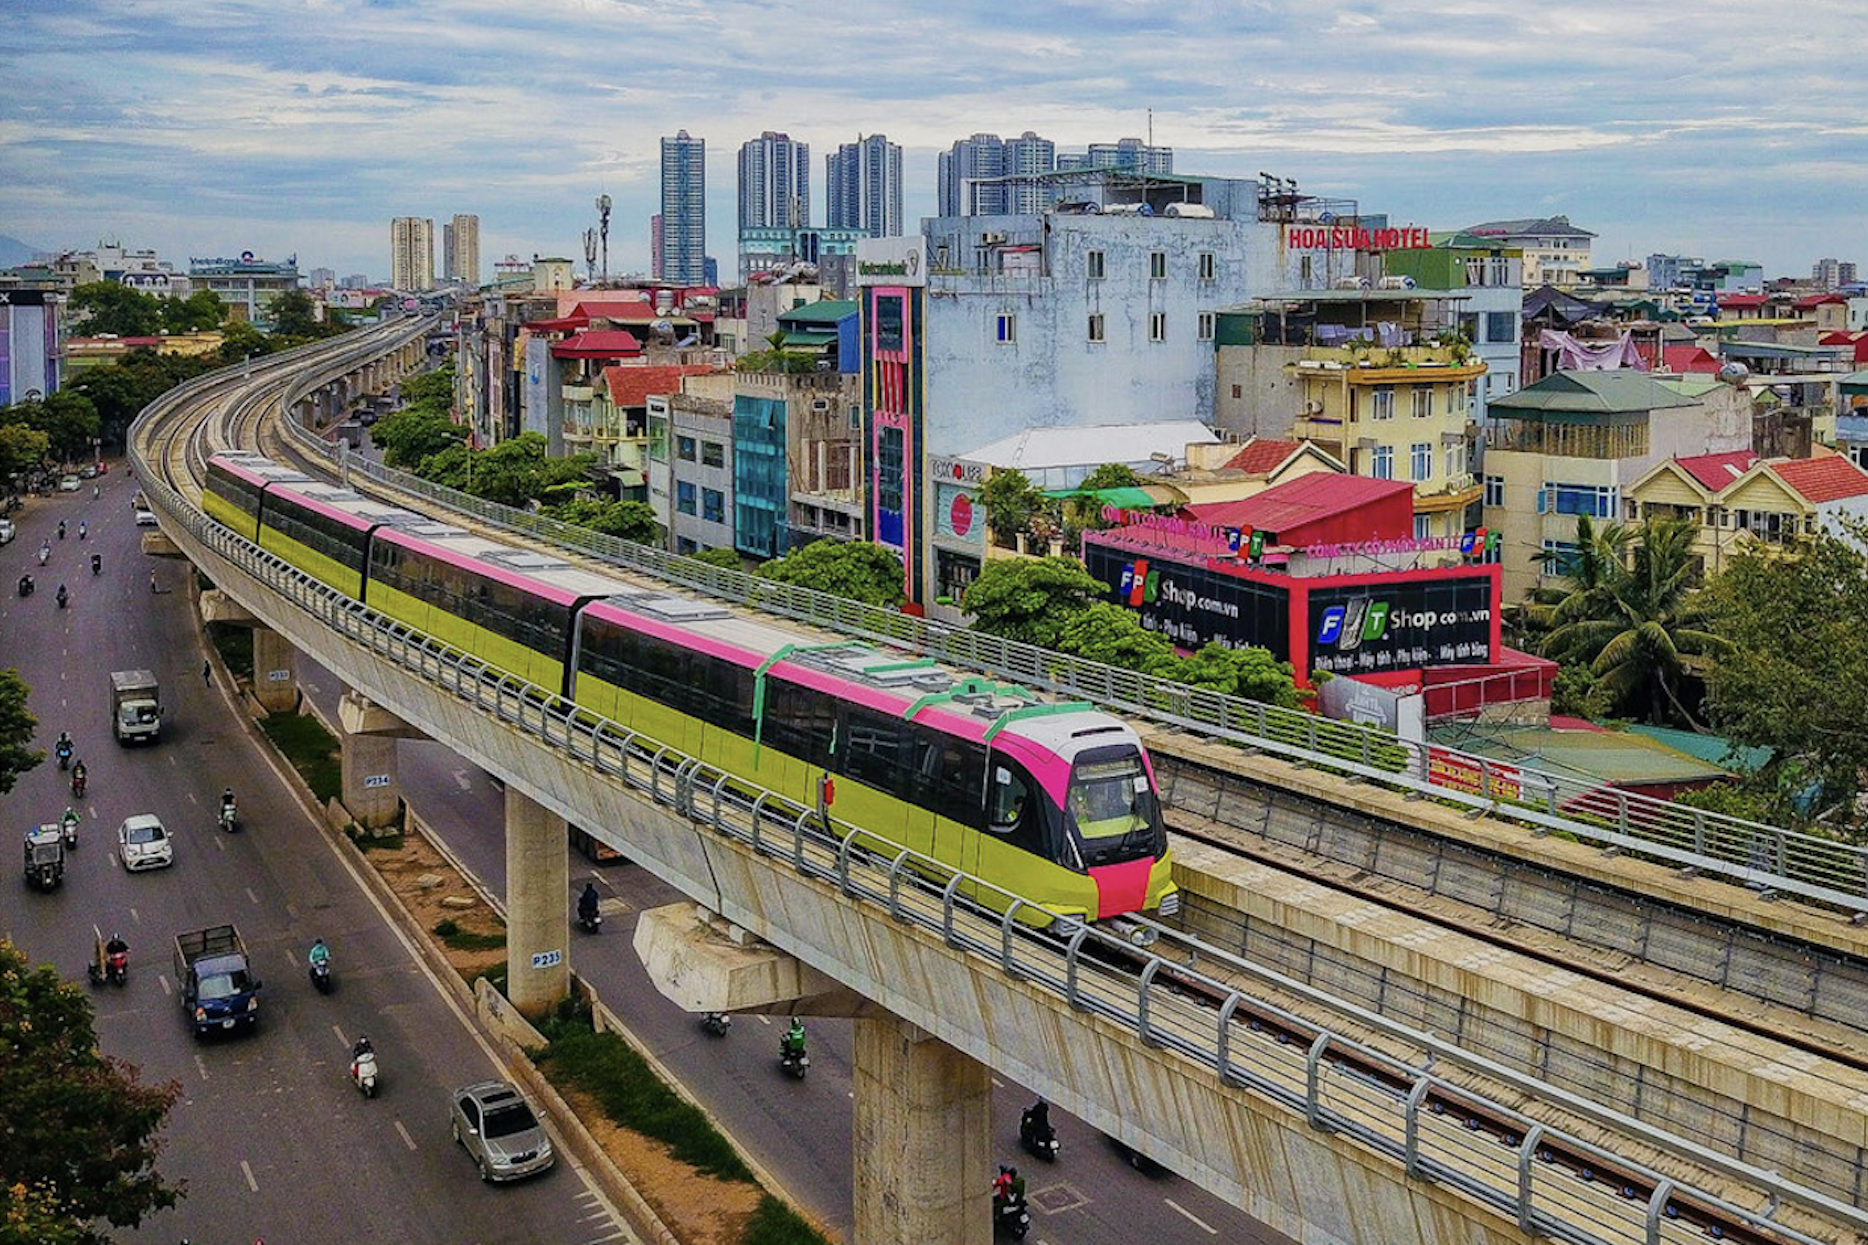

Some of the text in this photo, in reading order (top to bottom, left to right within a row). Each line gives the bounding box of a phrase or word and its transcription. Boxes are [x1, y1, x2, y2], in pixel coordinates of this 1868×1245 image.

[1290, 228, 1328, 249] HOA
[1373, 227, 1433, 249] HOTEL
[1229, 529, 1263, 555] FPT
[1461, 530, 1498, 552] FPT
[533, 951, 560, 965] P235
